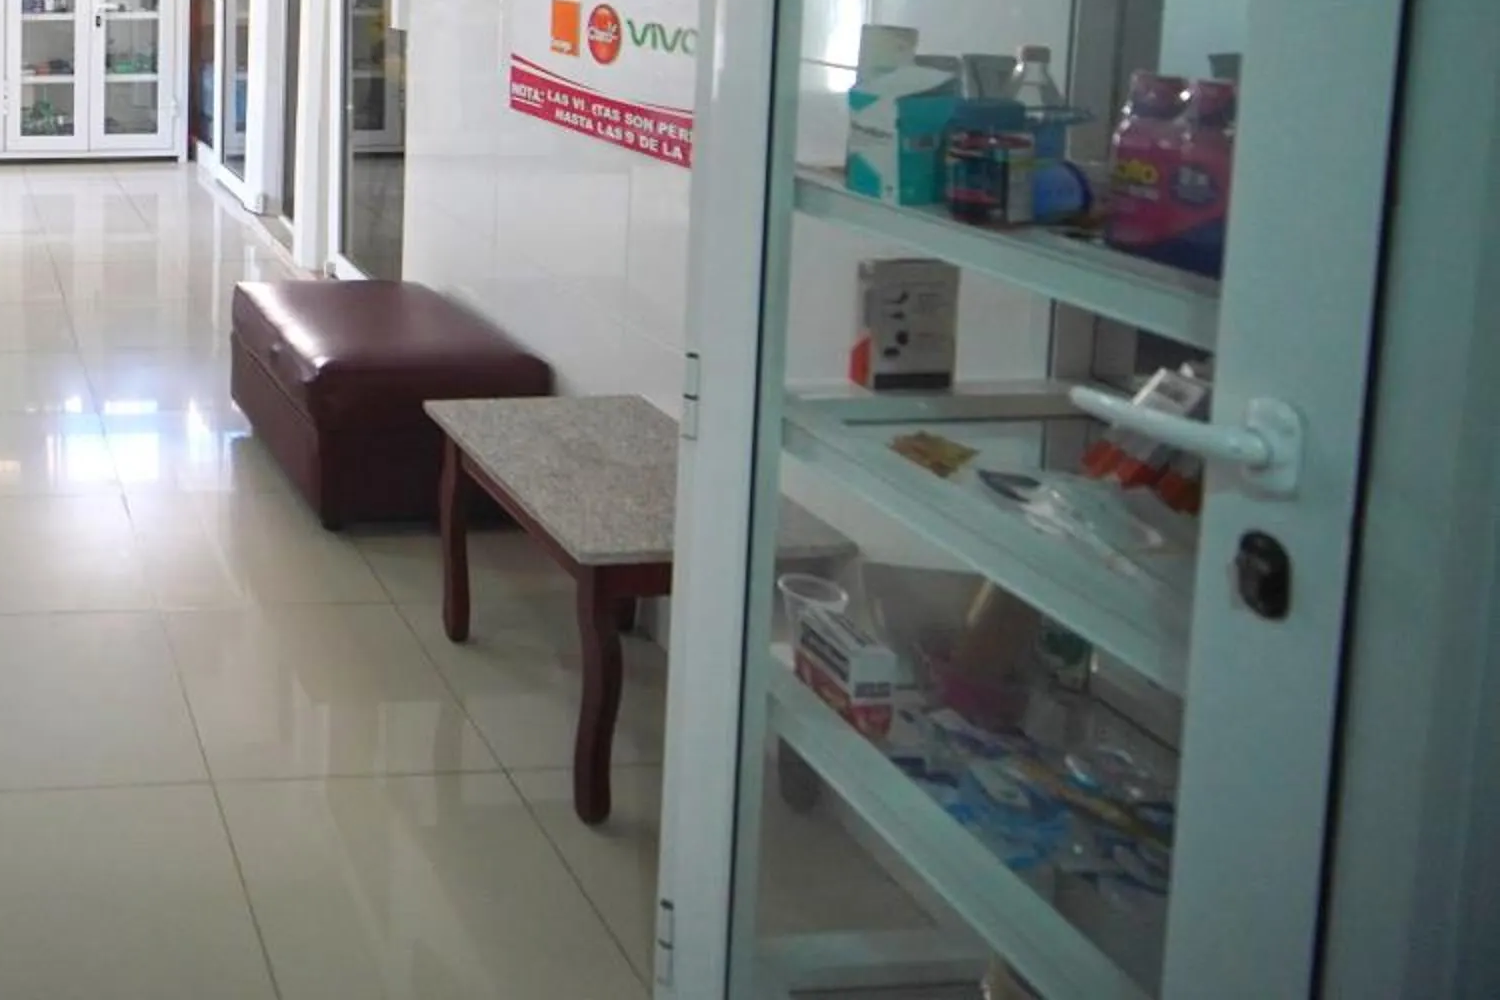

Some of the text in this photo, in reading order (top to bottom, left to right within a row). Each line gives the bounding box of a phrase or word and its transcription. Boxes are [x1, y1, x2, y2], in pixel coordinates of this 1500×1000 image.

[547, 89, 570, 106] LAS
[572, 95, 621, 122] VIITAS
[624, 112, 654, 133] SON
[555, 109, 594, 131] HASTA
[597, 121, 623, 141] LAS
[639, 134, 661, 152] DE
[662, 142, 684, 161] LA
